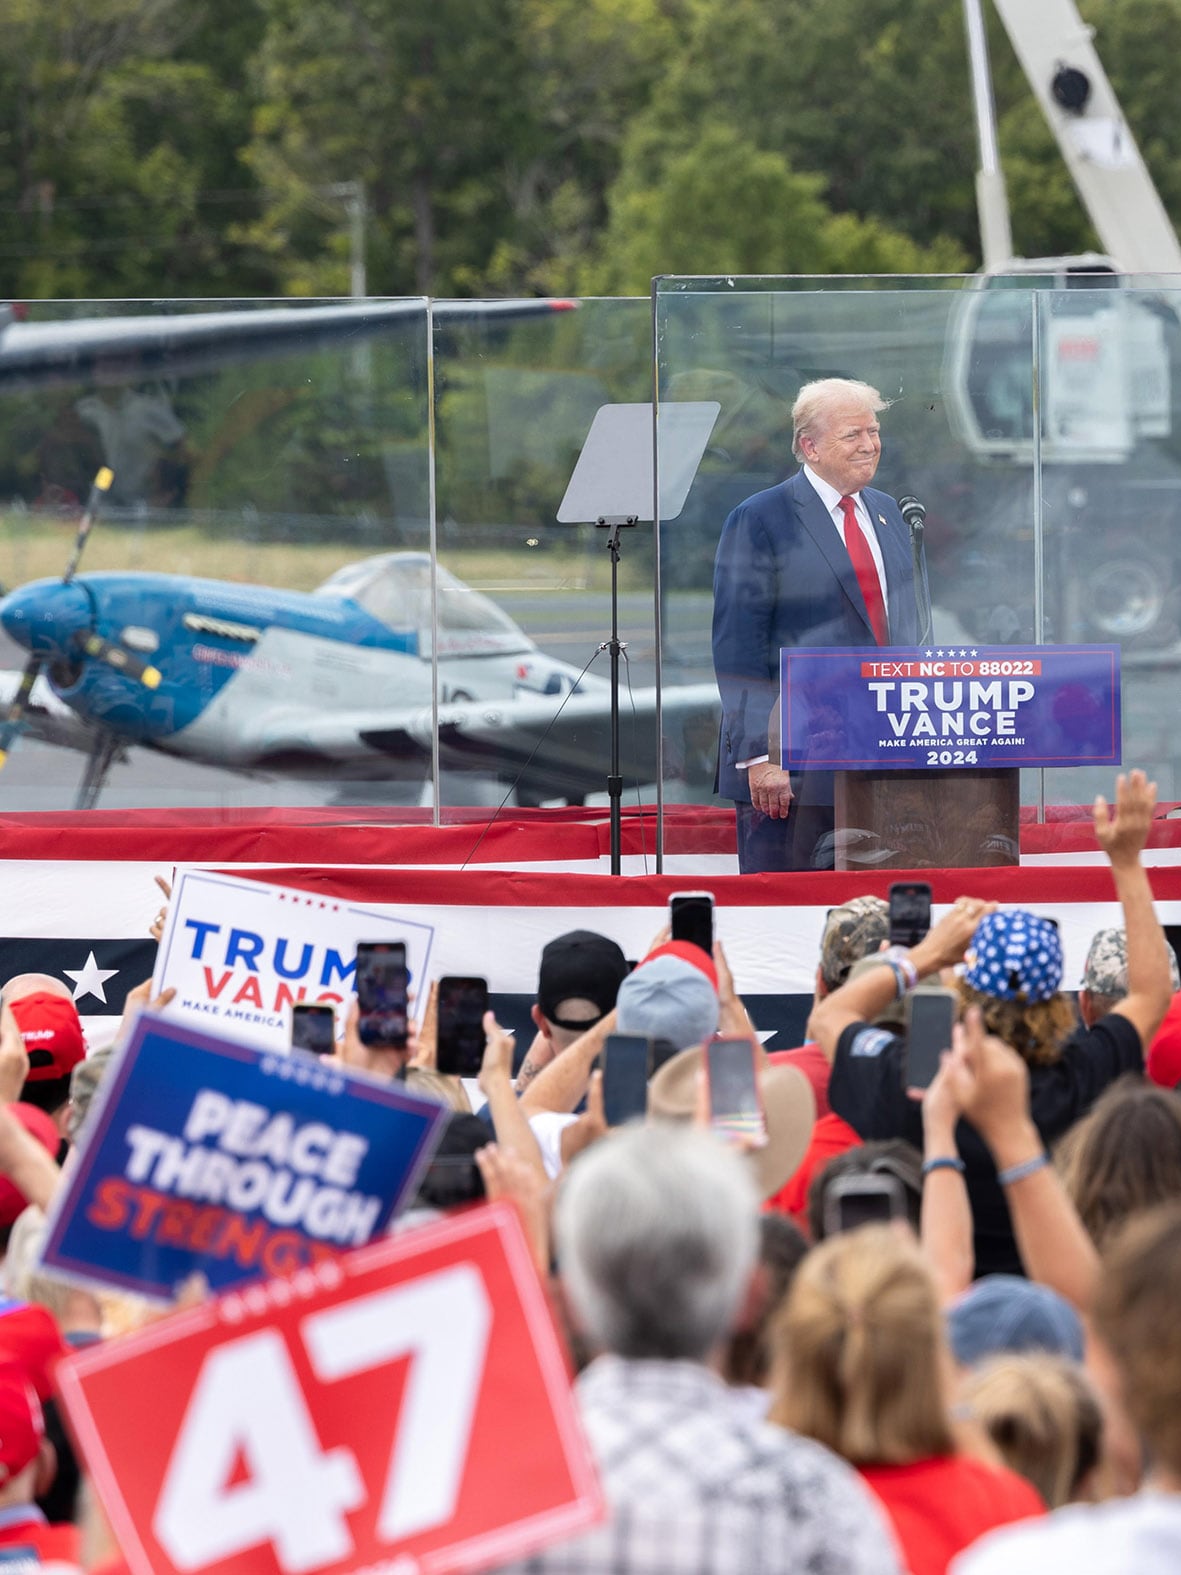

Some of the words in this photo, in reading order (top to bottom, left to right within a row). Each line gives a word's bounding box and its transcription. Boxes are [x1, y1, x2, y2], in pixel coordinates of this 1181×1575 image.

[869, 663, 914, 677] TEXT
[919, 662, 945, 676] NC
[950, 662, 974, 676] TO
[979, 661, 1034, 675] 88022
[868, 681, 1035, 712] TRUMP
[887, 711, 1016, 737] VANCE
[878, 739, 906, 747] MAKE
[909, 738, 953, 747] AMERICA
[956, 738, 988, 746] GREAT
[991, 737, 1025, 745] AGAIN!
[926, 750, 978, 765] 2024
[185, 918, 370, 992] TRUM
[182, 1000, 219, 1016] MAKE
[224, 1008, 285, 1030] AMERICA
[183, 1087, 369, 1187] PEACE
[125, 1123, 383, 1248] THROUGH
[153, 1260, 493, 1575] 47
